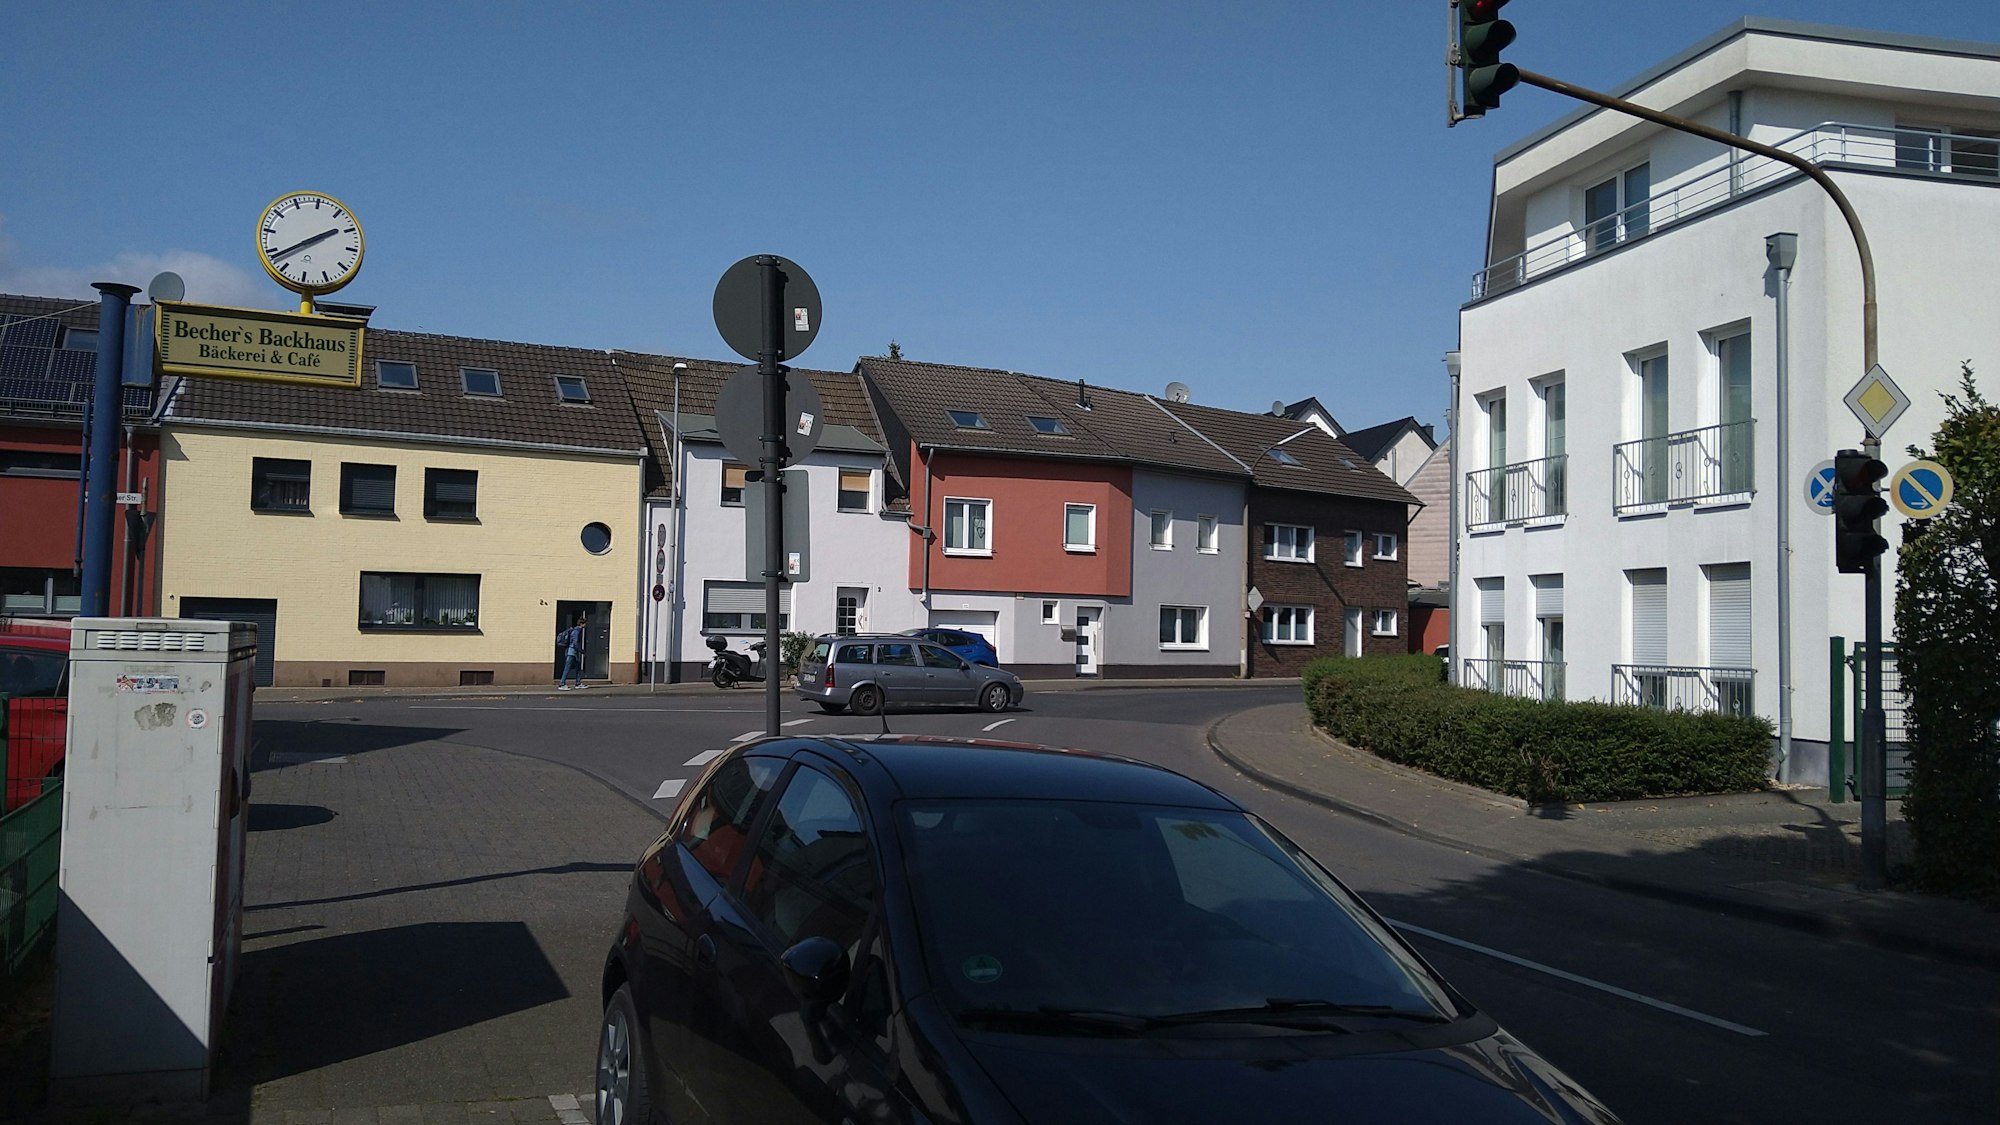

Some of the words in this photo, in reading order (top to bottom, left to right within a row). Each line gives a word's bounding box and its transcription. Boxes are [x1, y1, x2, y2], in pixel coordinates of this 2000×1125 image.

[258, 328, 346, 353] Backhaus
[198, 343, 266, 363] Bäckerei
[270, 350, 283, 364] &
[287, 351, 321, 368] Café
